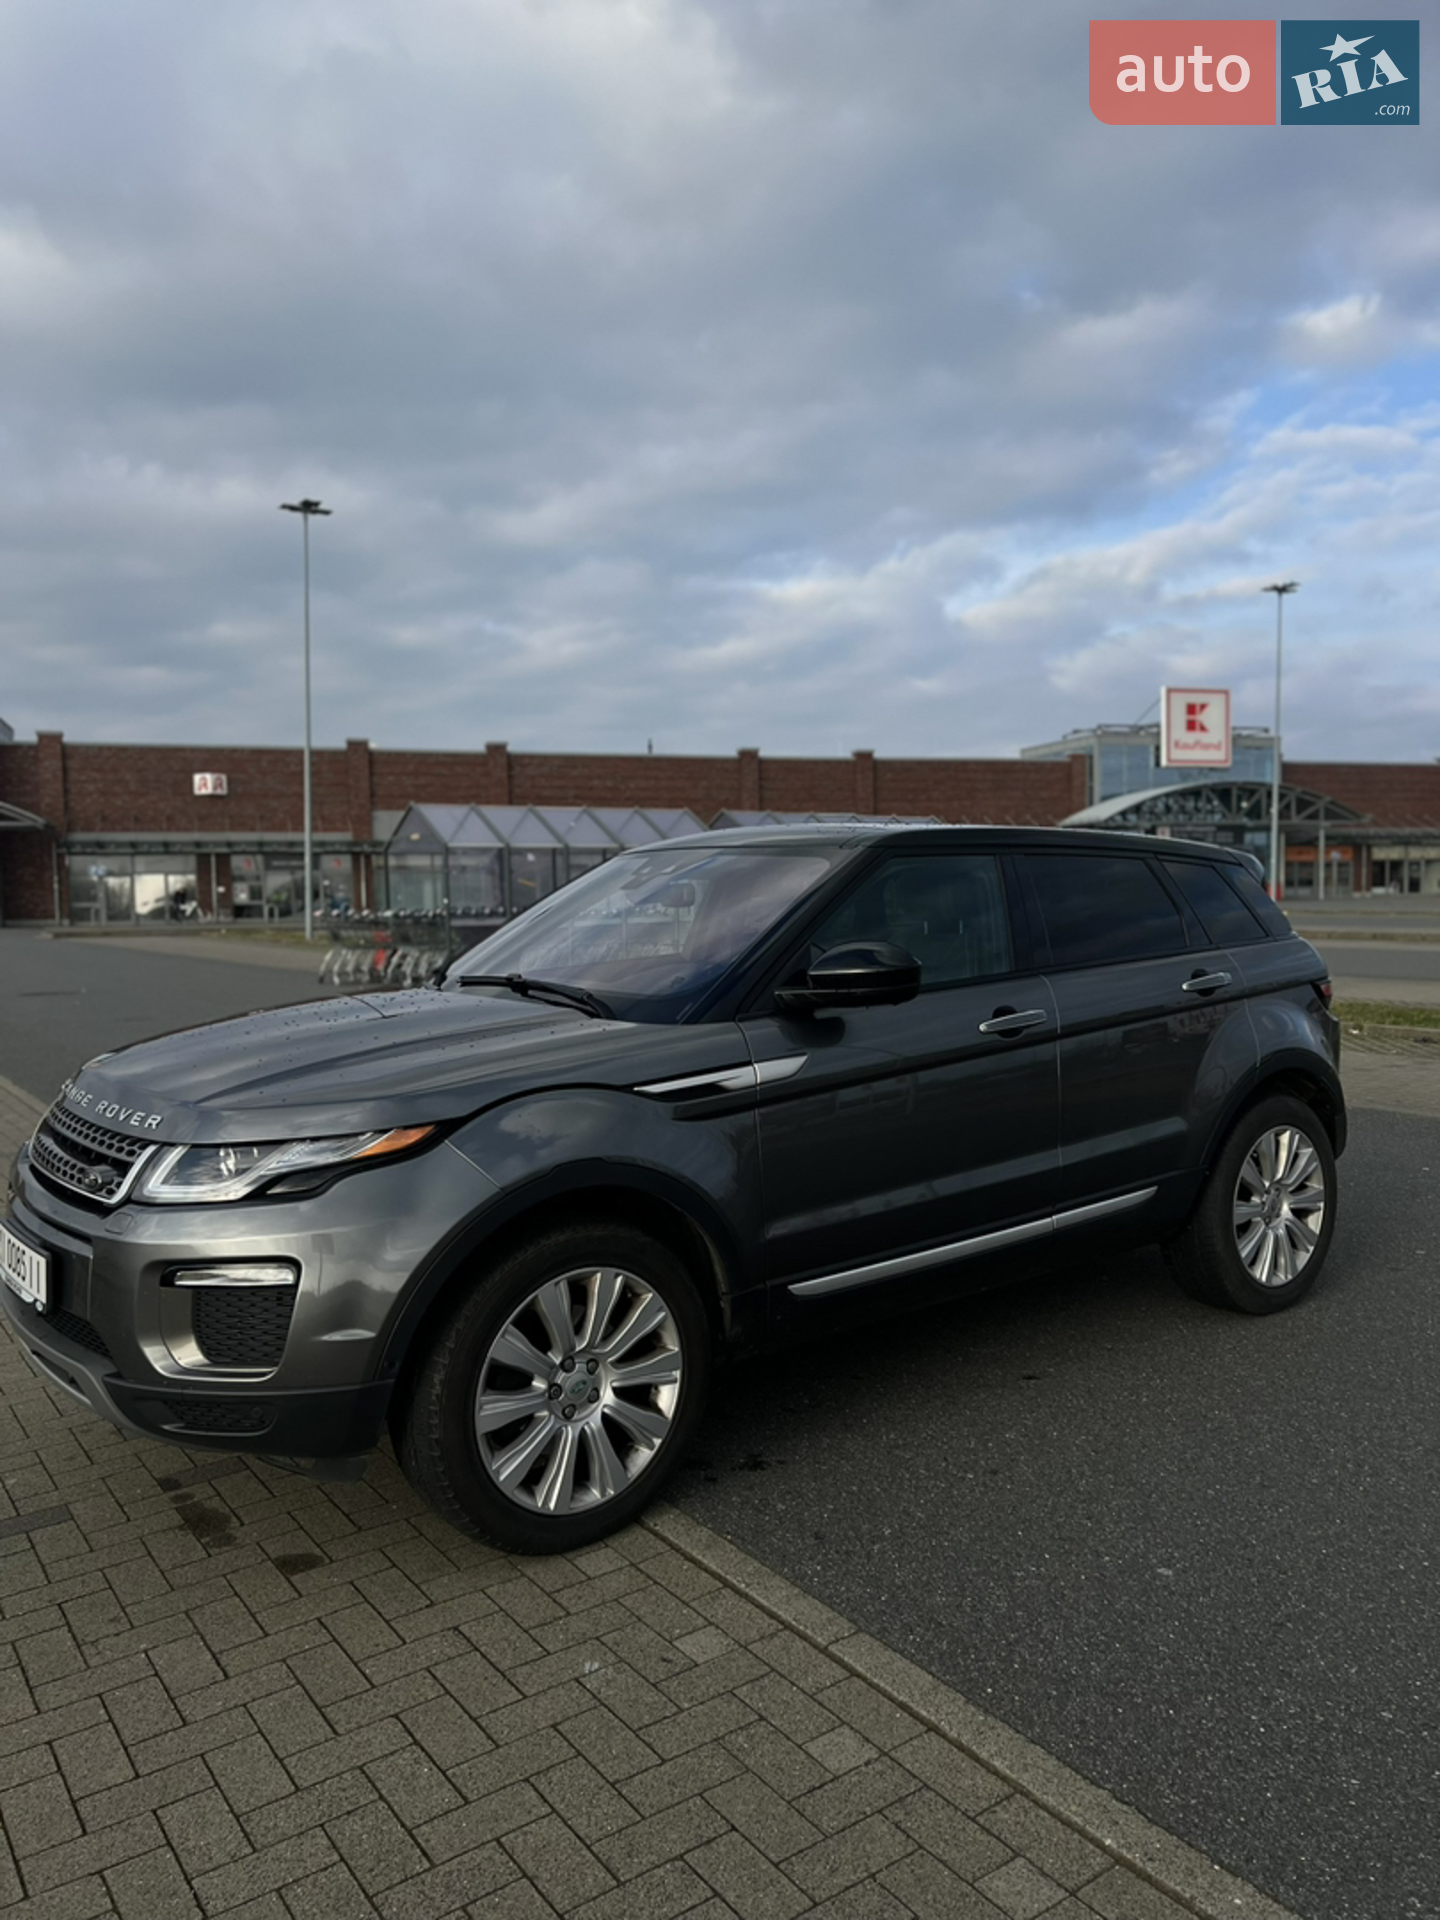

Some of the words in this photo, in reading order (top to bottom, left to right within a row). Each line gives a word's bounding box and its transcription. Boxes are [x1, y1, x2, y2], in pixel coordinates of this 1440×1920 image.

[1186, 703, 1209, 732] K
[1173, 740, 1222, 752] Kaufland
[95, 1100, 162, 1130] ROVER
